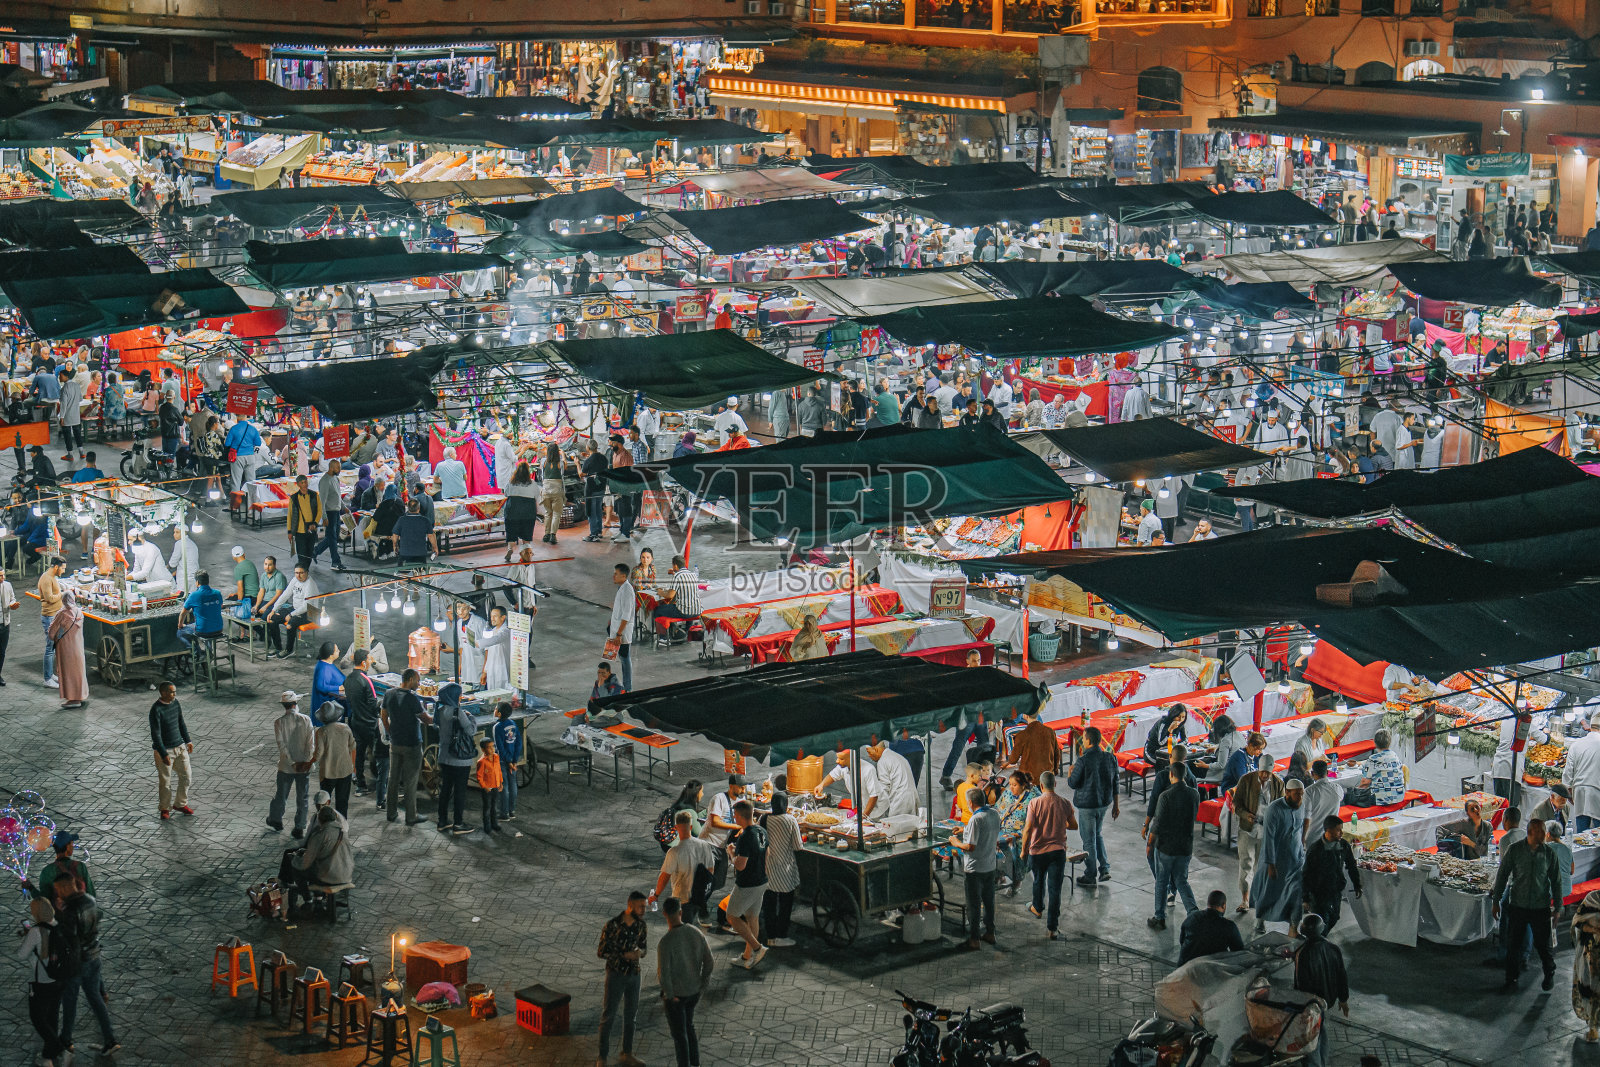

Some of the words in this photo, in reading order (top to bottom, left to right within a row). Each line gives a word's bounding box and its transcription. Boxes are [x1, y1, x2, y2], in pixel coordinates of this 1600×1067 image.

[1446, 310, 1463, 322] 12
[862, 336, 879, 356] 32
[1346, 411, 1358, 427] 36
[935, 590, 961, 605] N°97
